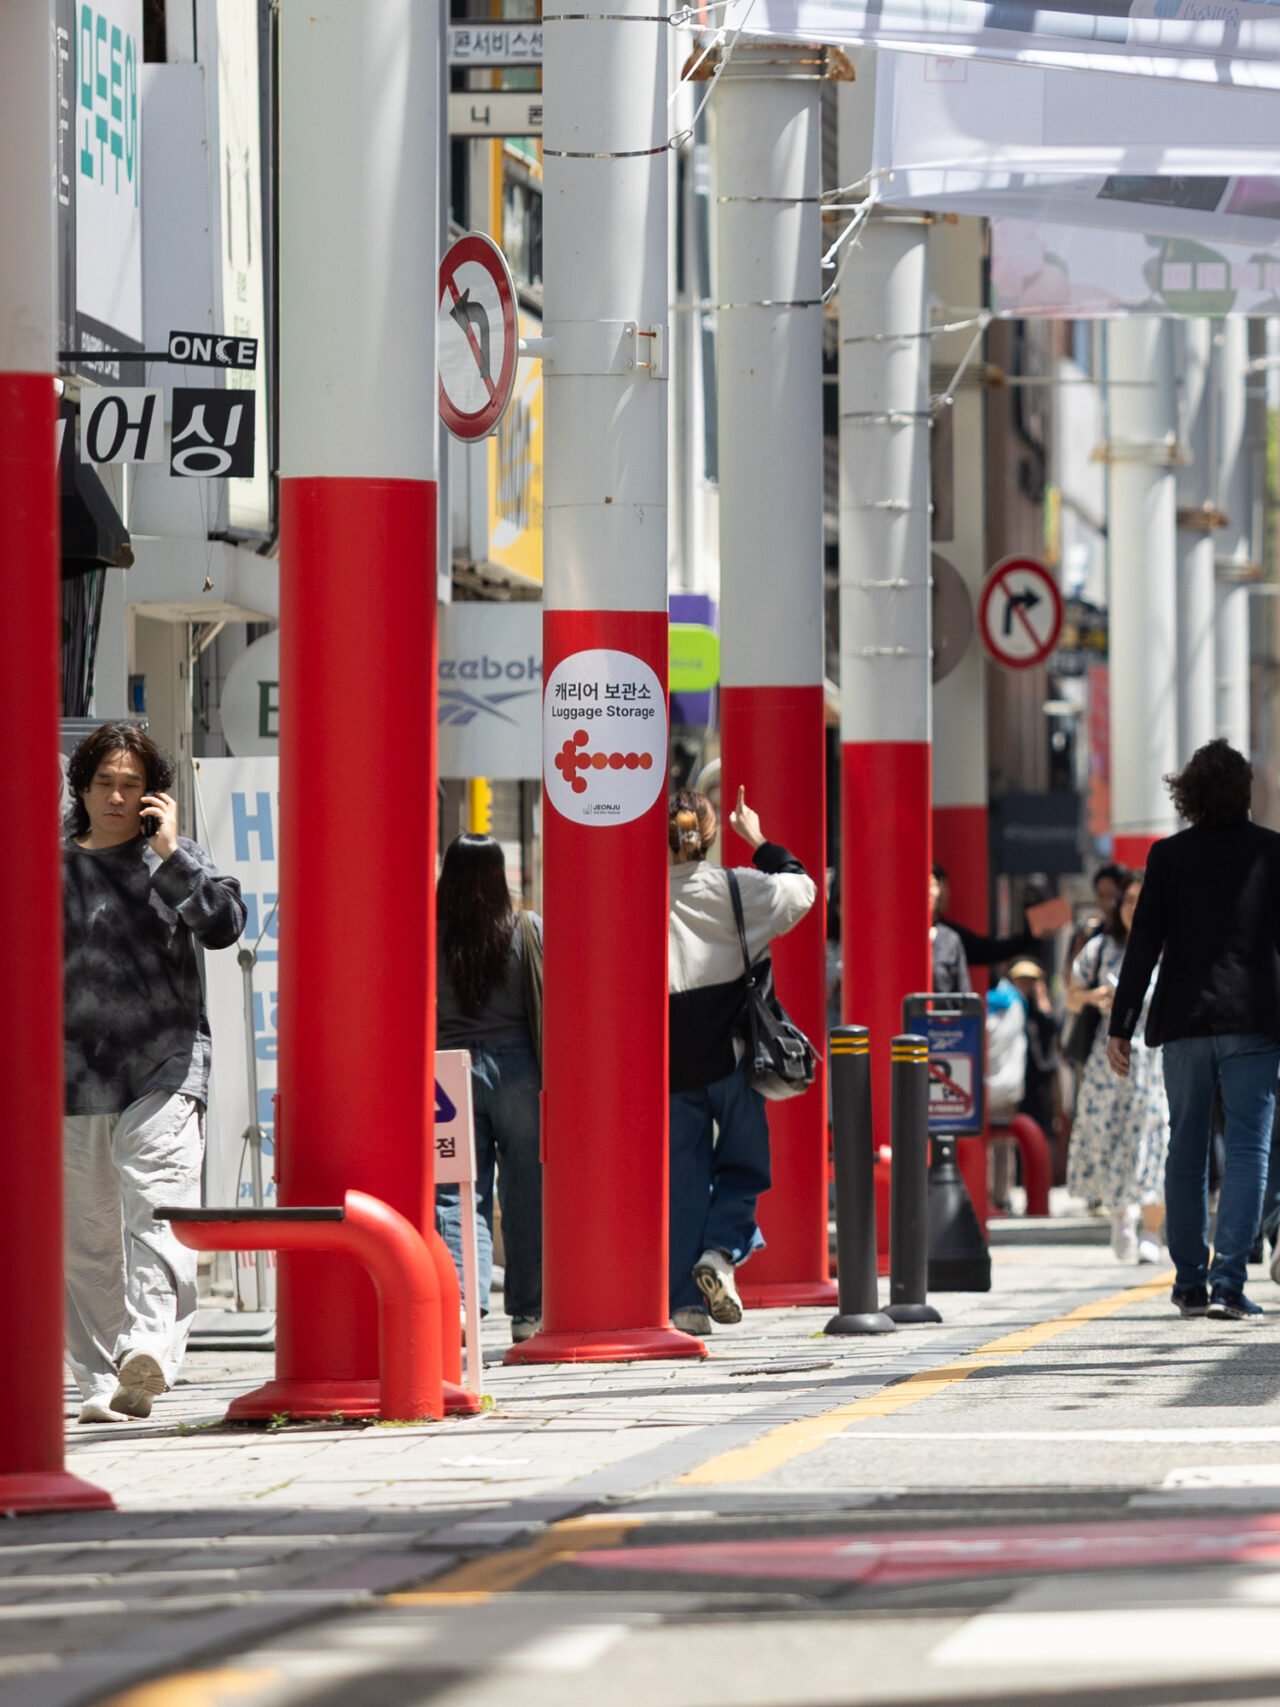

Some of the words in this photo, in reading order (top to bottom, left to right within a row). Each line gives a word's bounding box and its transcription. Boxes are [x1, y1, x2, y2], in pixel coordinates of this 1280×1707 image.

[81, 4, 138, 208] 모두투어
[169, 336, 256, 365] ONCE
[555, 682, 598, 701] 캐리어
[604, 682, 651, 701] 보관소
[552, 706, 602, 720] Luggage
[606, 705, 655, 720] Storage
[593, 803, 621, 811] JEONJU
